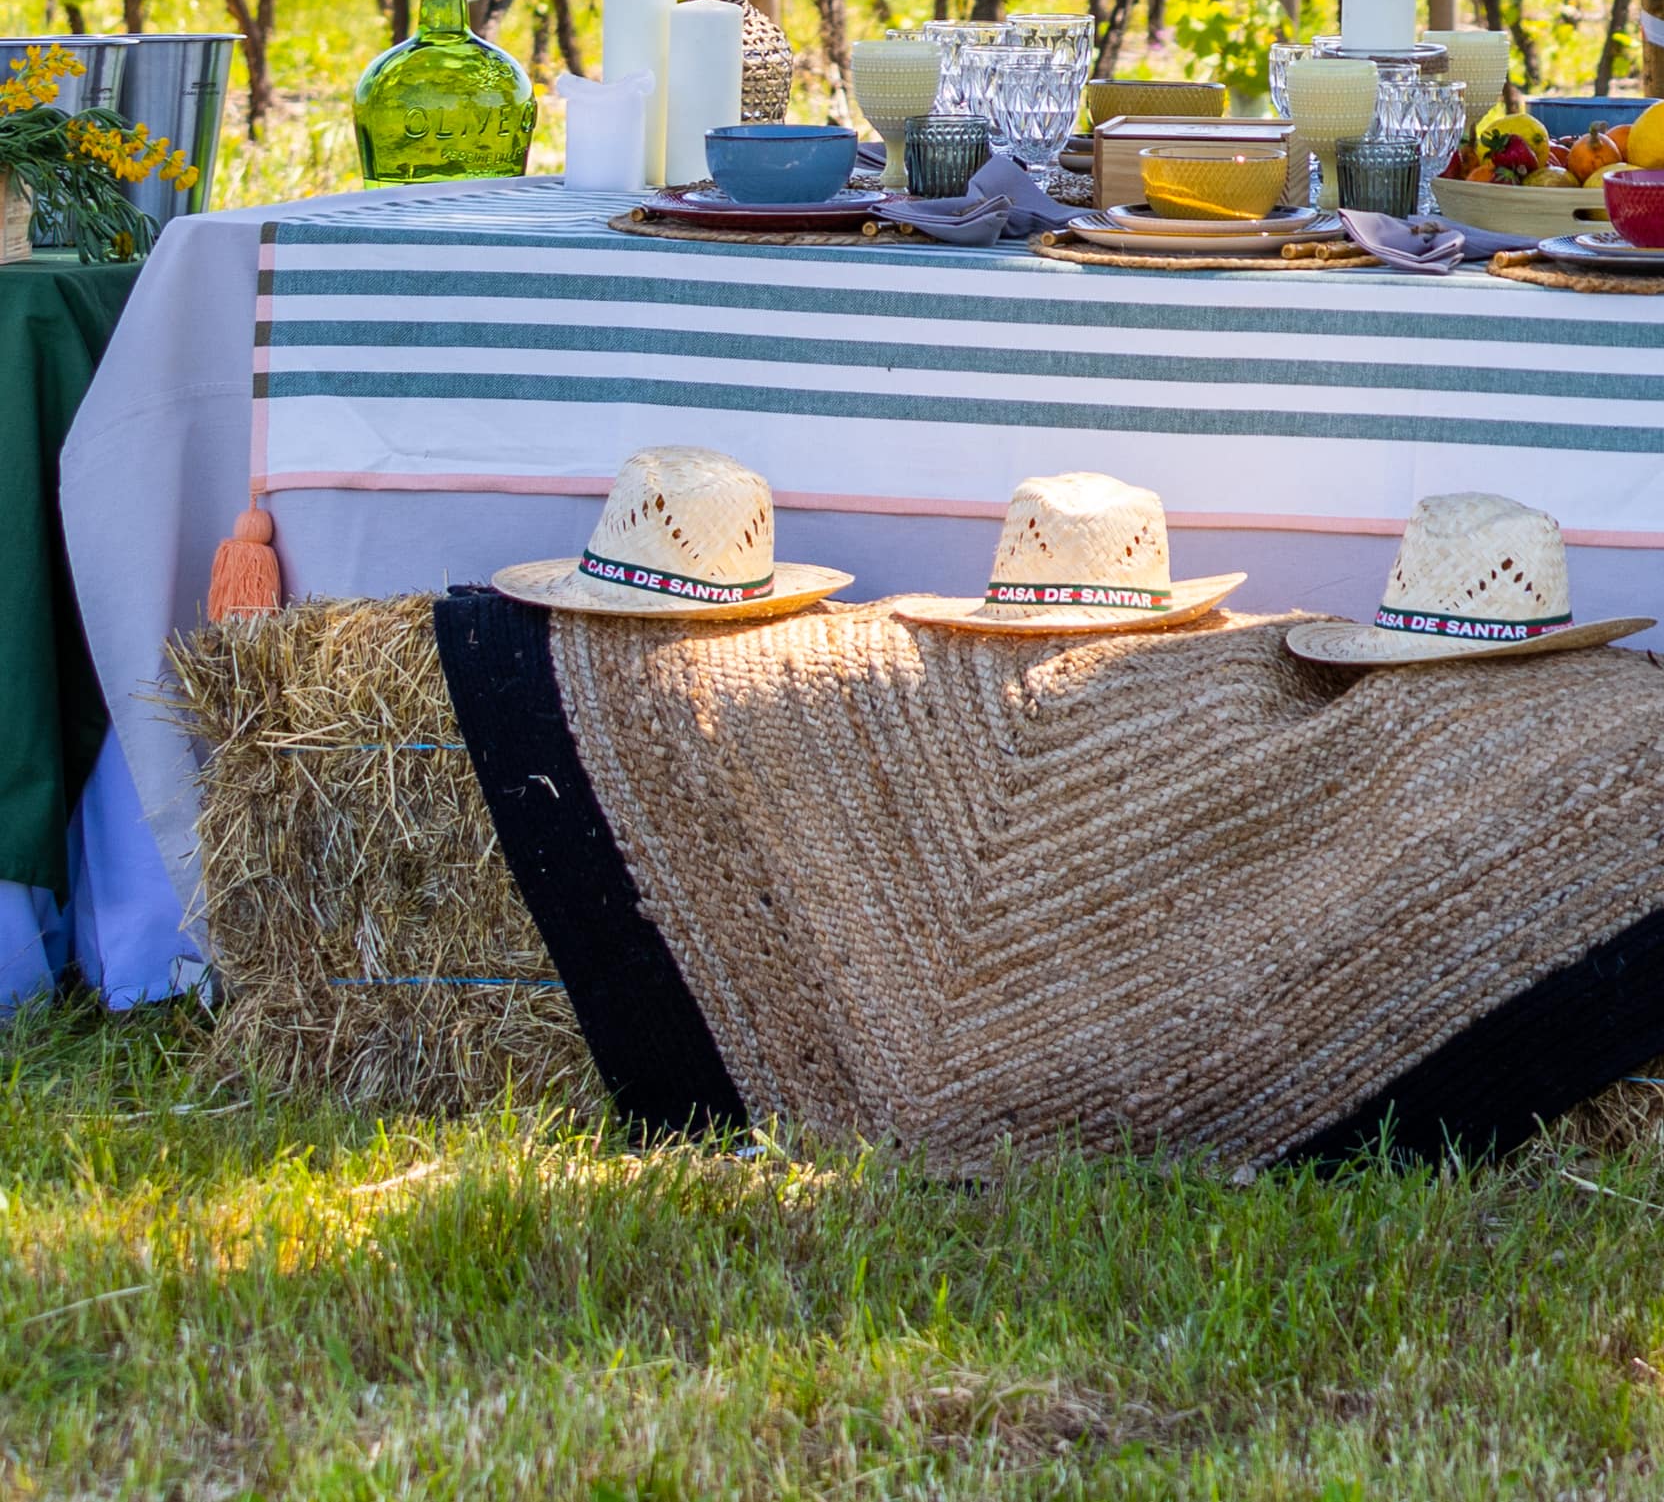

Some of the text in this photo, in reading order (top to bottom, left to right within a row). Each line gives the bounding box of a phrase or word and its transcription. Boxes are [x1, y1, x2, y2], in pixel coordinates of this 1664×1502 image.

[404, 104, 510, 139] OLIVE
[587, 558, 626, 581] CASA
[633, 570, 663, 589] DE
[668, 578, 743, 602] SANTAR
[998, 586, 1037, 602] CASA
[1044, 587, 1074, 603] DE
[1079, 588, 1152, 609] SANTAR
[1376, 611, 1405, 629] CASA
[1411, 616, 1440, 632] DE
[1444, 620, 1527, 639] SANTAR
